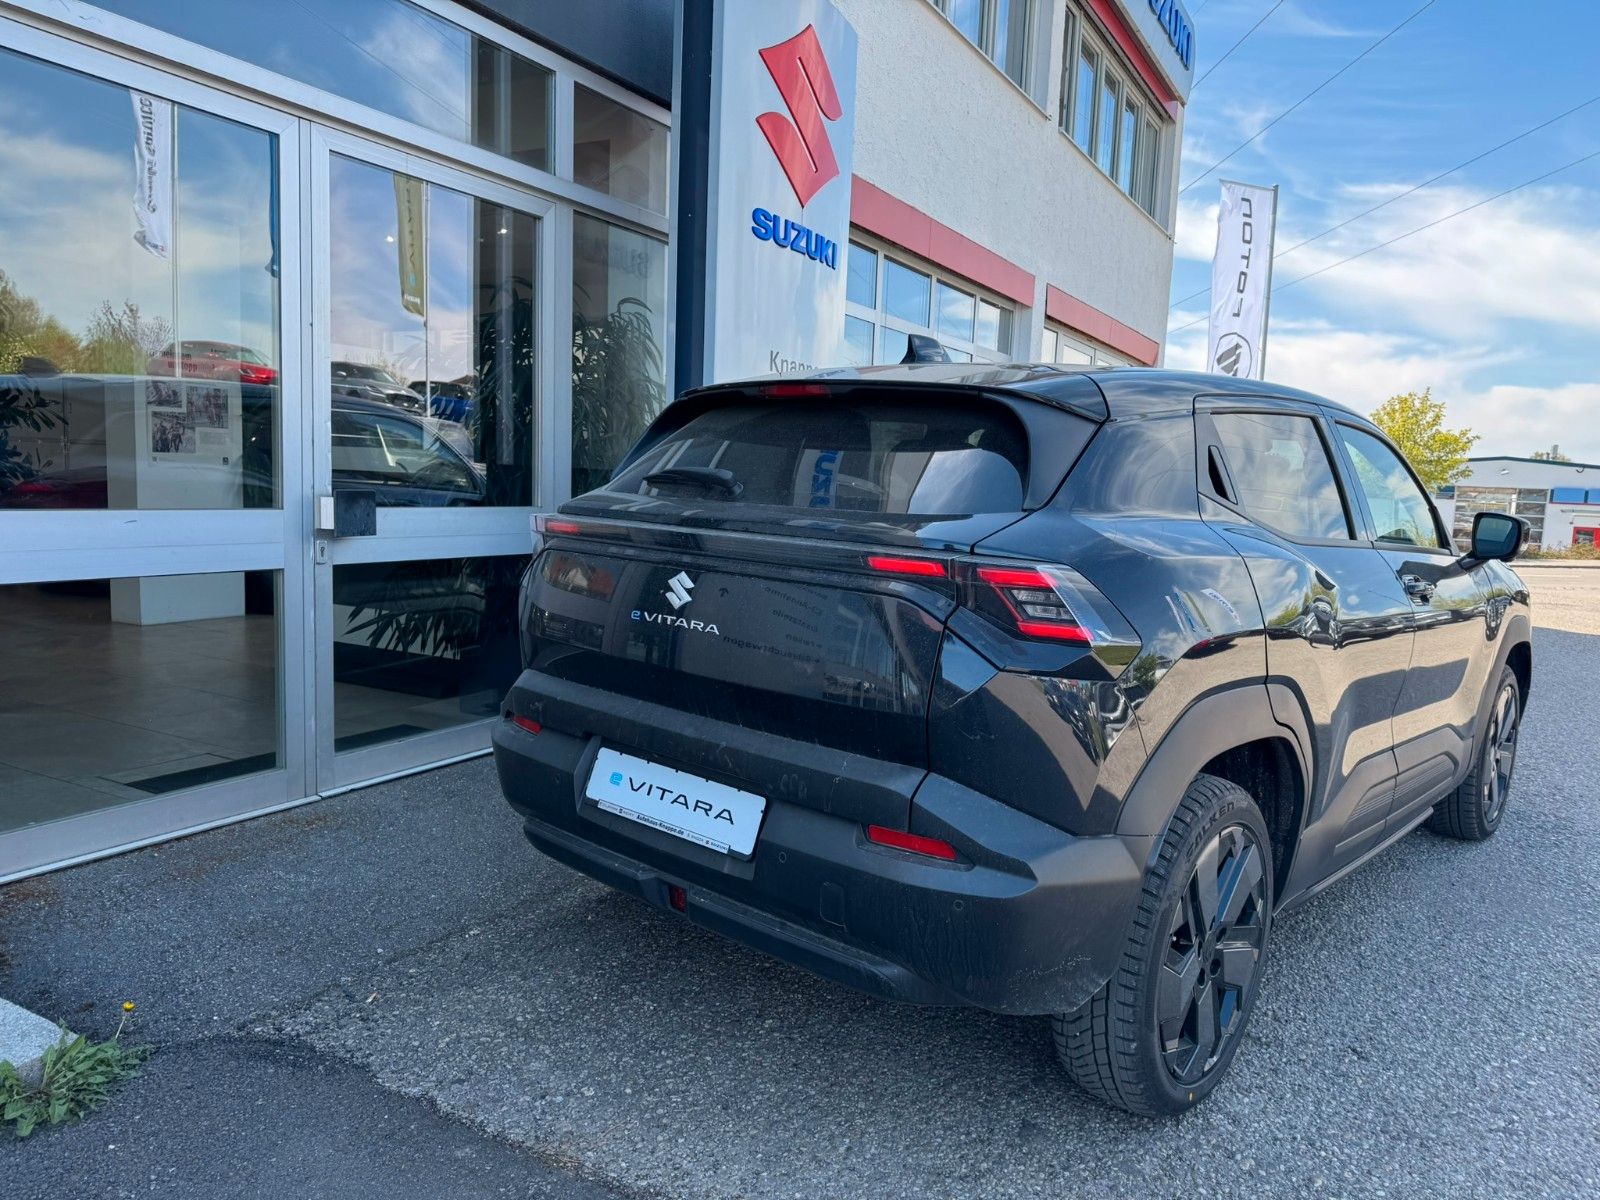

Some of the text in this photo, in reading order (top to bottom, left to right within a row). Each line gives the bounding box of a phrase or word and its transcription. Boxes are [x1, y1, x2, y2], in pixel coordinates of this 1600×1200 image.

[752, 207, 837, 270] SUZUKI
[644, 611, 719, 635] VITARA
[629, 776, 735, 825] VITARA
